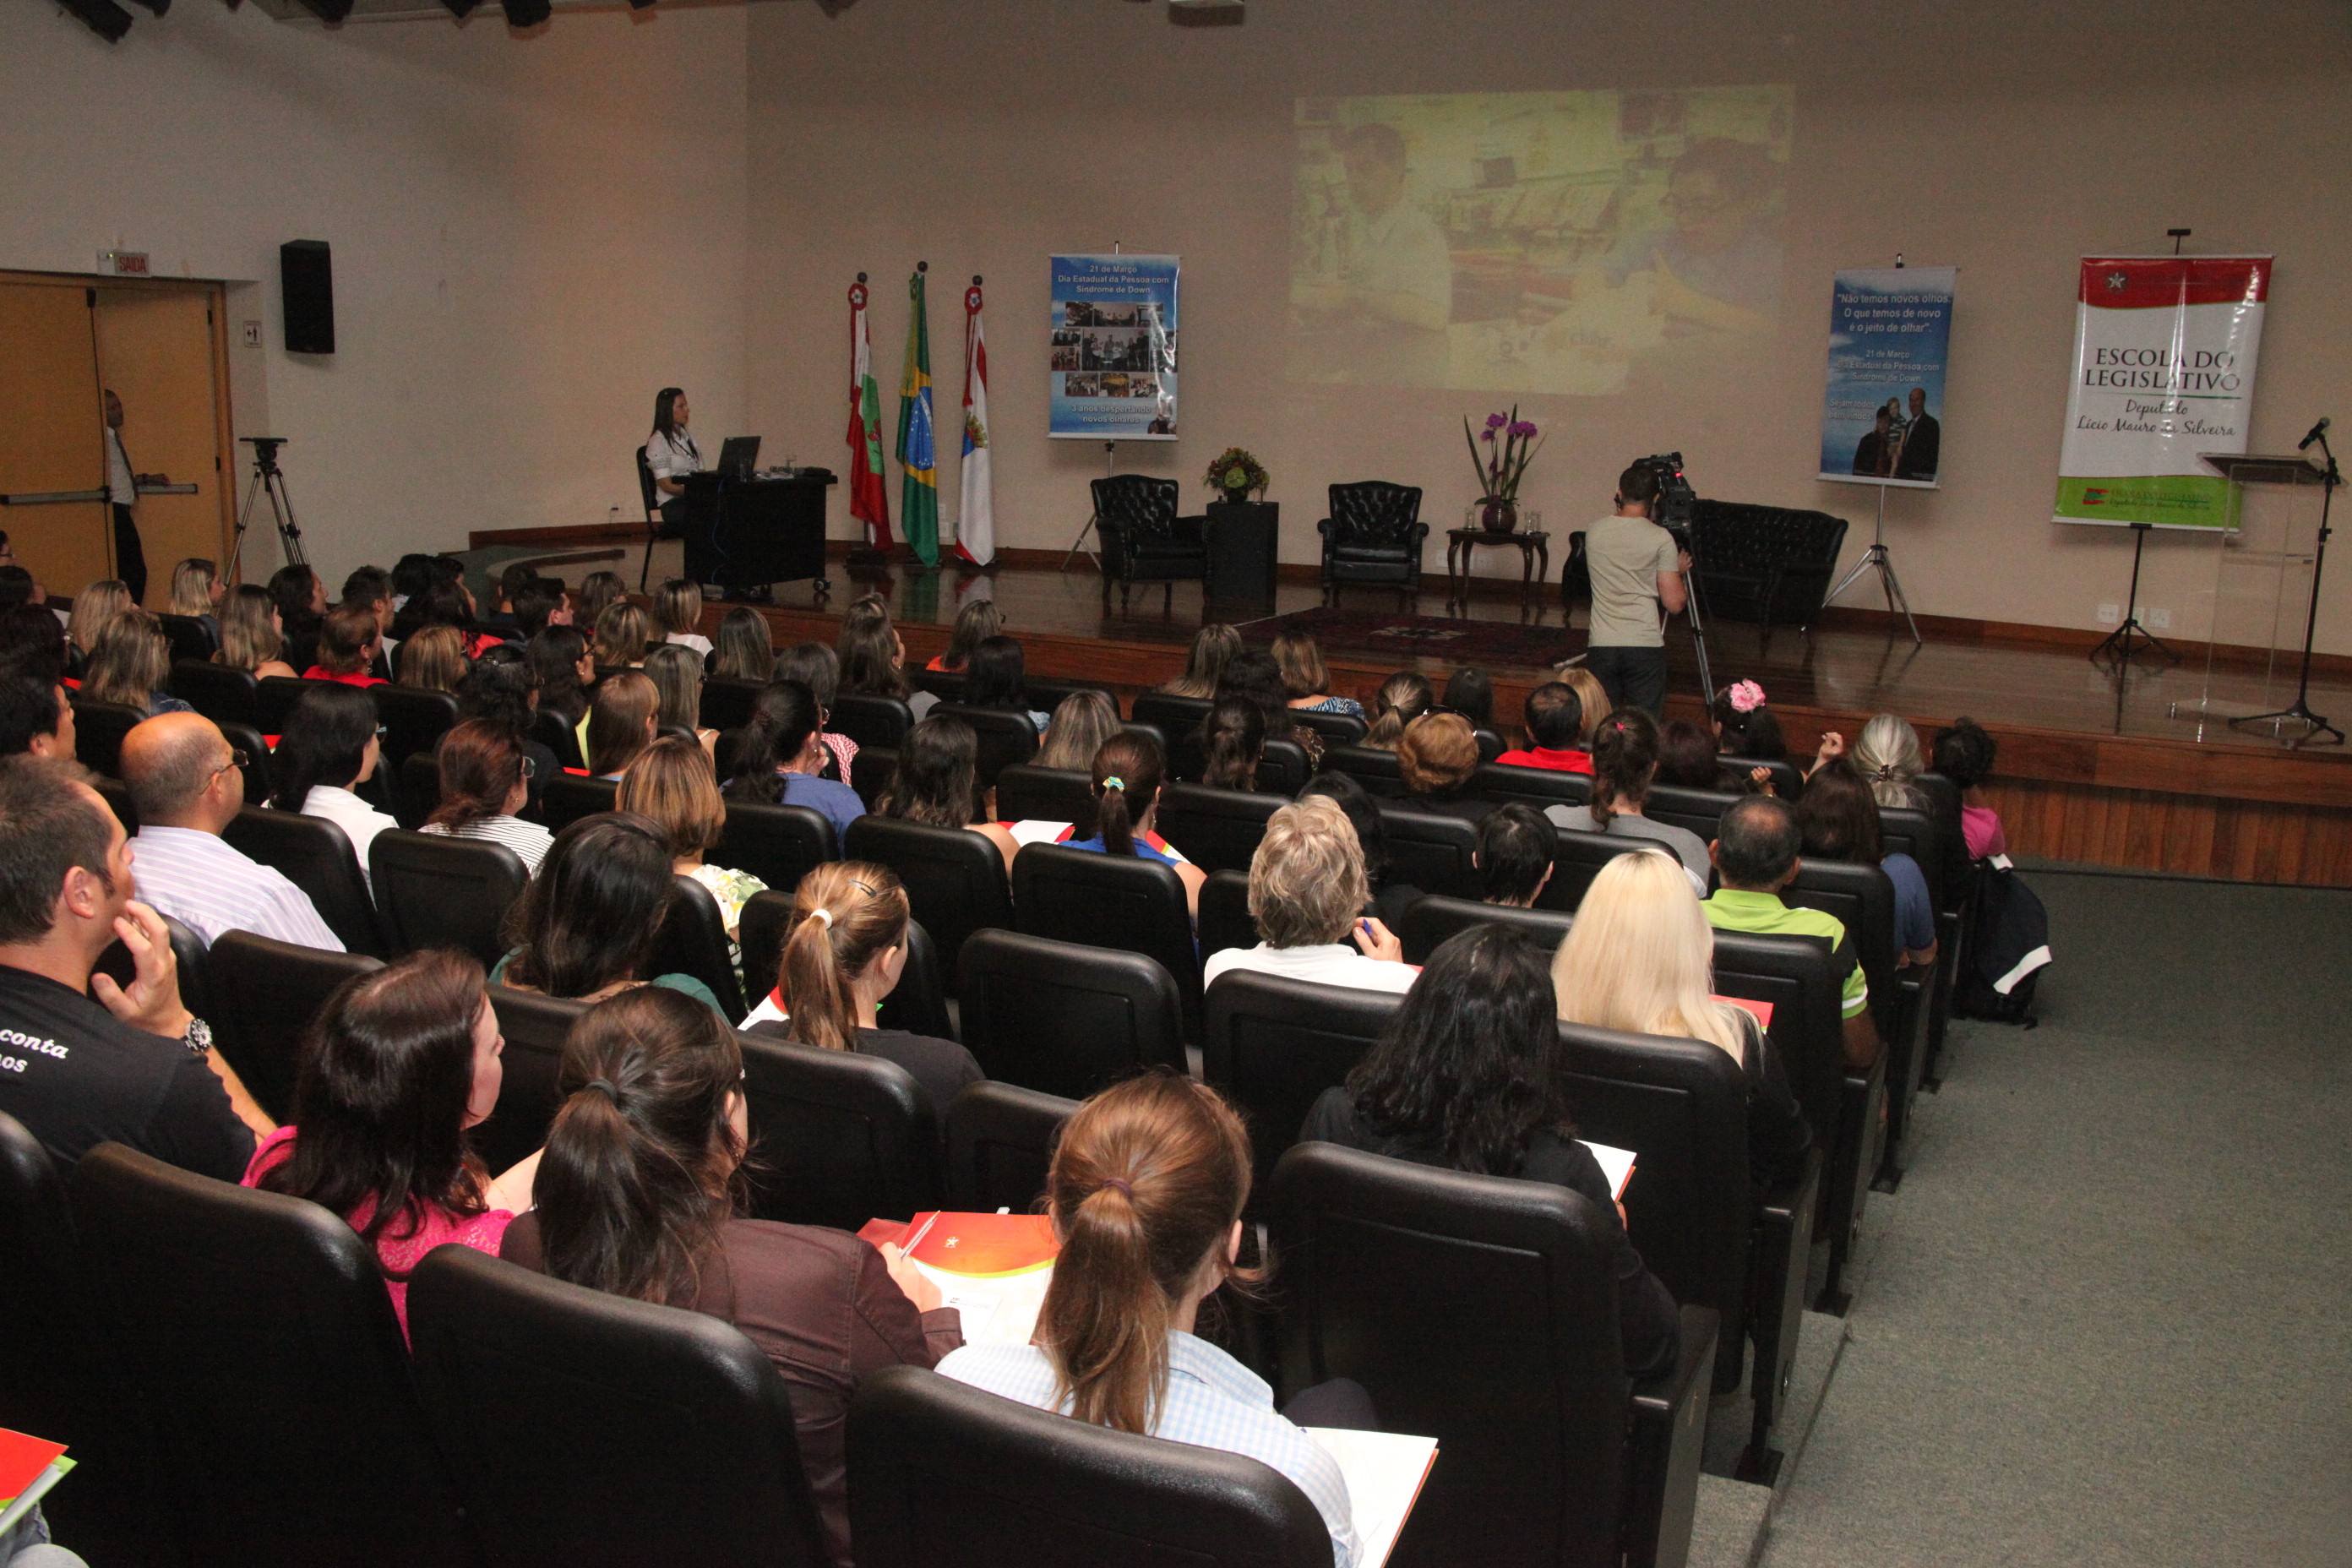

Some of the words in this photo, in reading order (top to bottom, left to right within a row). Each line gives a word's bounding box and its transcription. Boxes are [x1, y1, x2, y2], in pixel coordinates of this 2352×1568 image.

[1113, 265, 1137, 274] Março
[1058, 275, 1070, 283] Dia
[1073, 275, 1107, 283] Estadual
[1861, 295, 1888, 303] temos
[1891, 295, 1919, 303] novos
[1844, 308, 1851, 317] O
[1854, 310, 1870, 319] que
[1872, 309, 1900, 318] temos
[1903, 308, 1914, 318] de
[1849, 323, 1854, 332] é
[1865, 324, 1884, 334] jeito
[1886, 323, 1897, 332] de
[1886, 351, 1910, 359] Março
[2096, 348, 2186, 368] ESCOLA
[2195, 351, 2234, 369] DO
[1838, 361, 1848, 369] Dia
[1882, 362, 1892, 370] da
[1893, 362, 1921, 371] Pessoa
[1887, 373, 1897, 382] de
[1899, 373, 1921, 383] Down
[2084, 369, 2240, 391] LEGISLATIVO
[1101, 406, 1151, 414] despertando
[2126, 399, 2188, 421] Deputdo
[2111, 418, 2156, 433] Mauro
[2182, 420, 2236, 436] Silveira
[0, 1029, 69, 1059] conta
